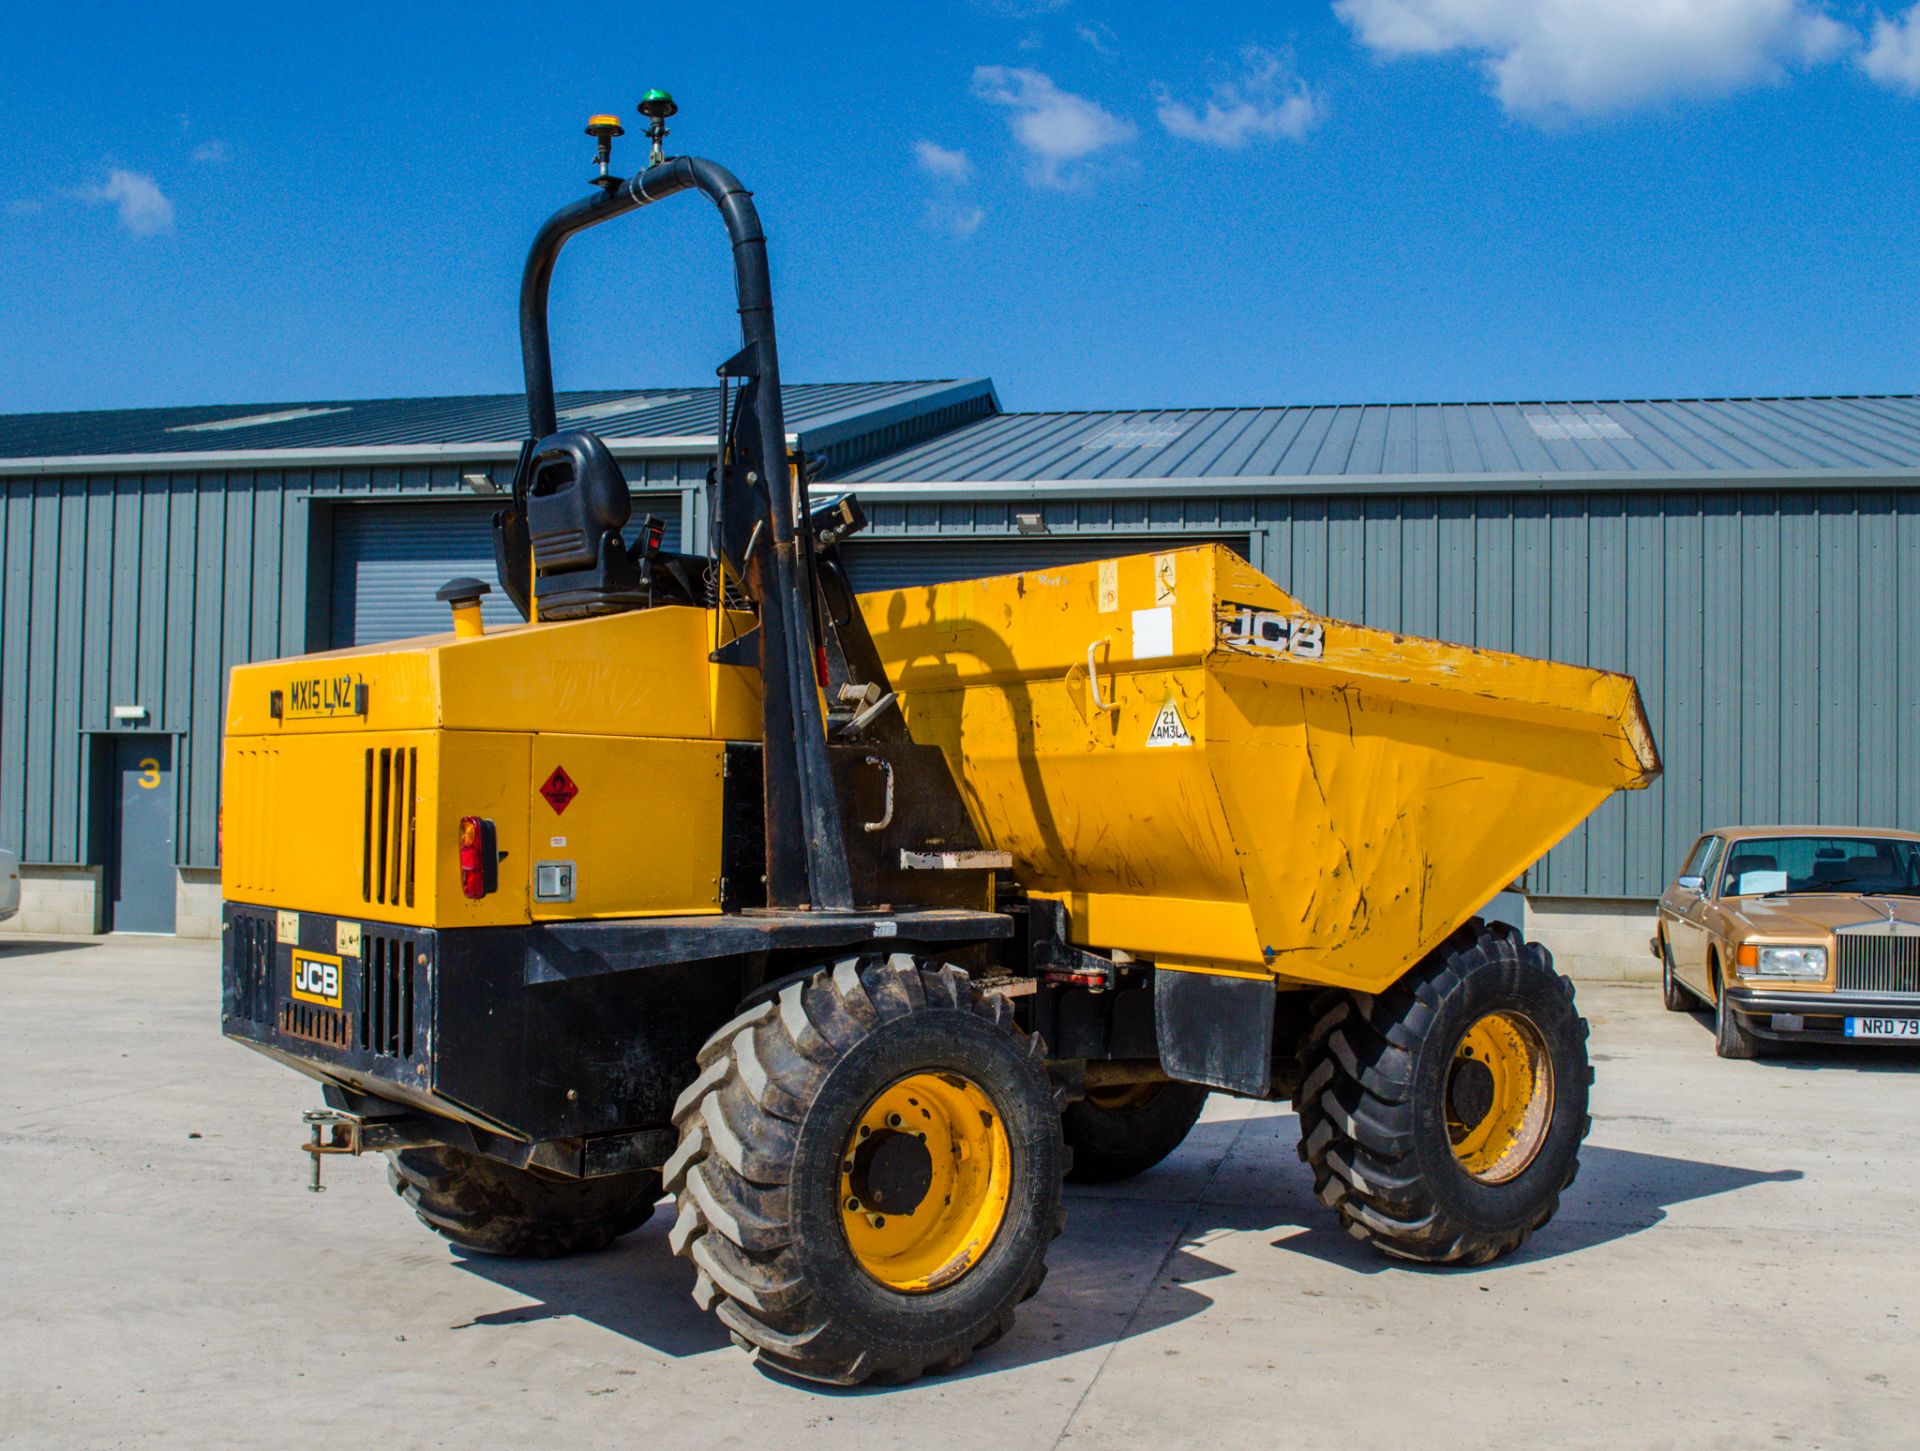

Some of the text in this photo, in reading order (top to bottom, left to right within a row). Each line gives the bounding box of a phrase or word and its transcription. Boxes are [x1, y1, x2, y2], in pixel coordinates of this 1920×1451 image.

[1221, 607, 1324, 658] JCB
[291, 677, 352, 711] MX15 LNZ
[1162, 710, 1176, 725] 21
[138, 757, 161, 789] 3
[295, 960, 339, 997] JCB
[1862, 1019, 1919, 1035] NRD 79
